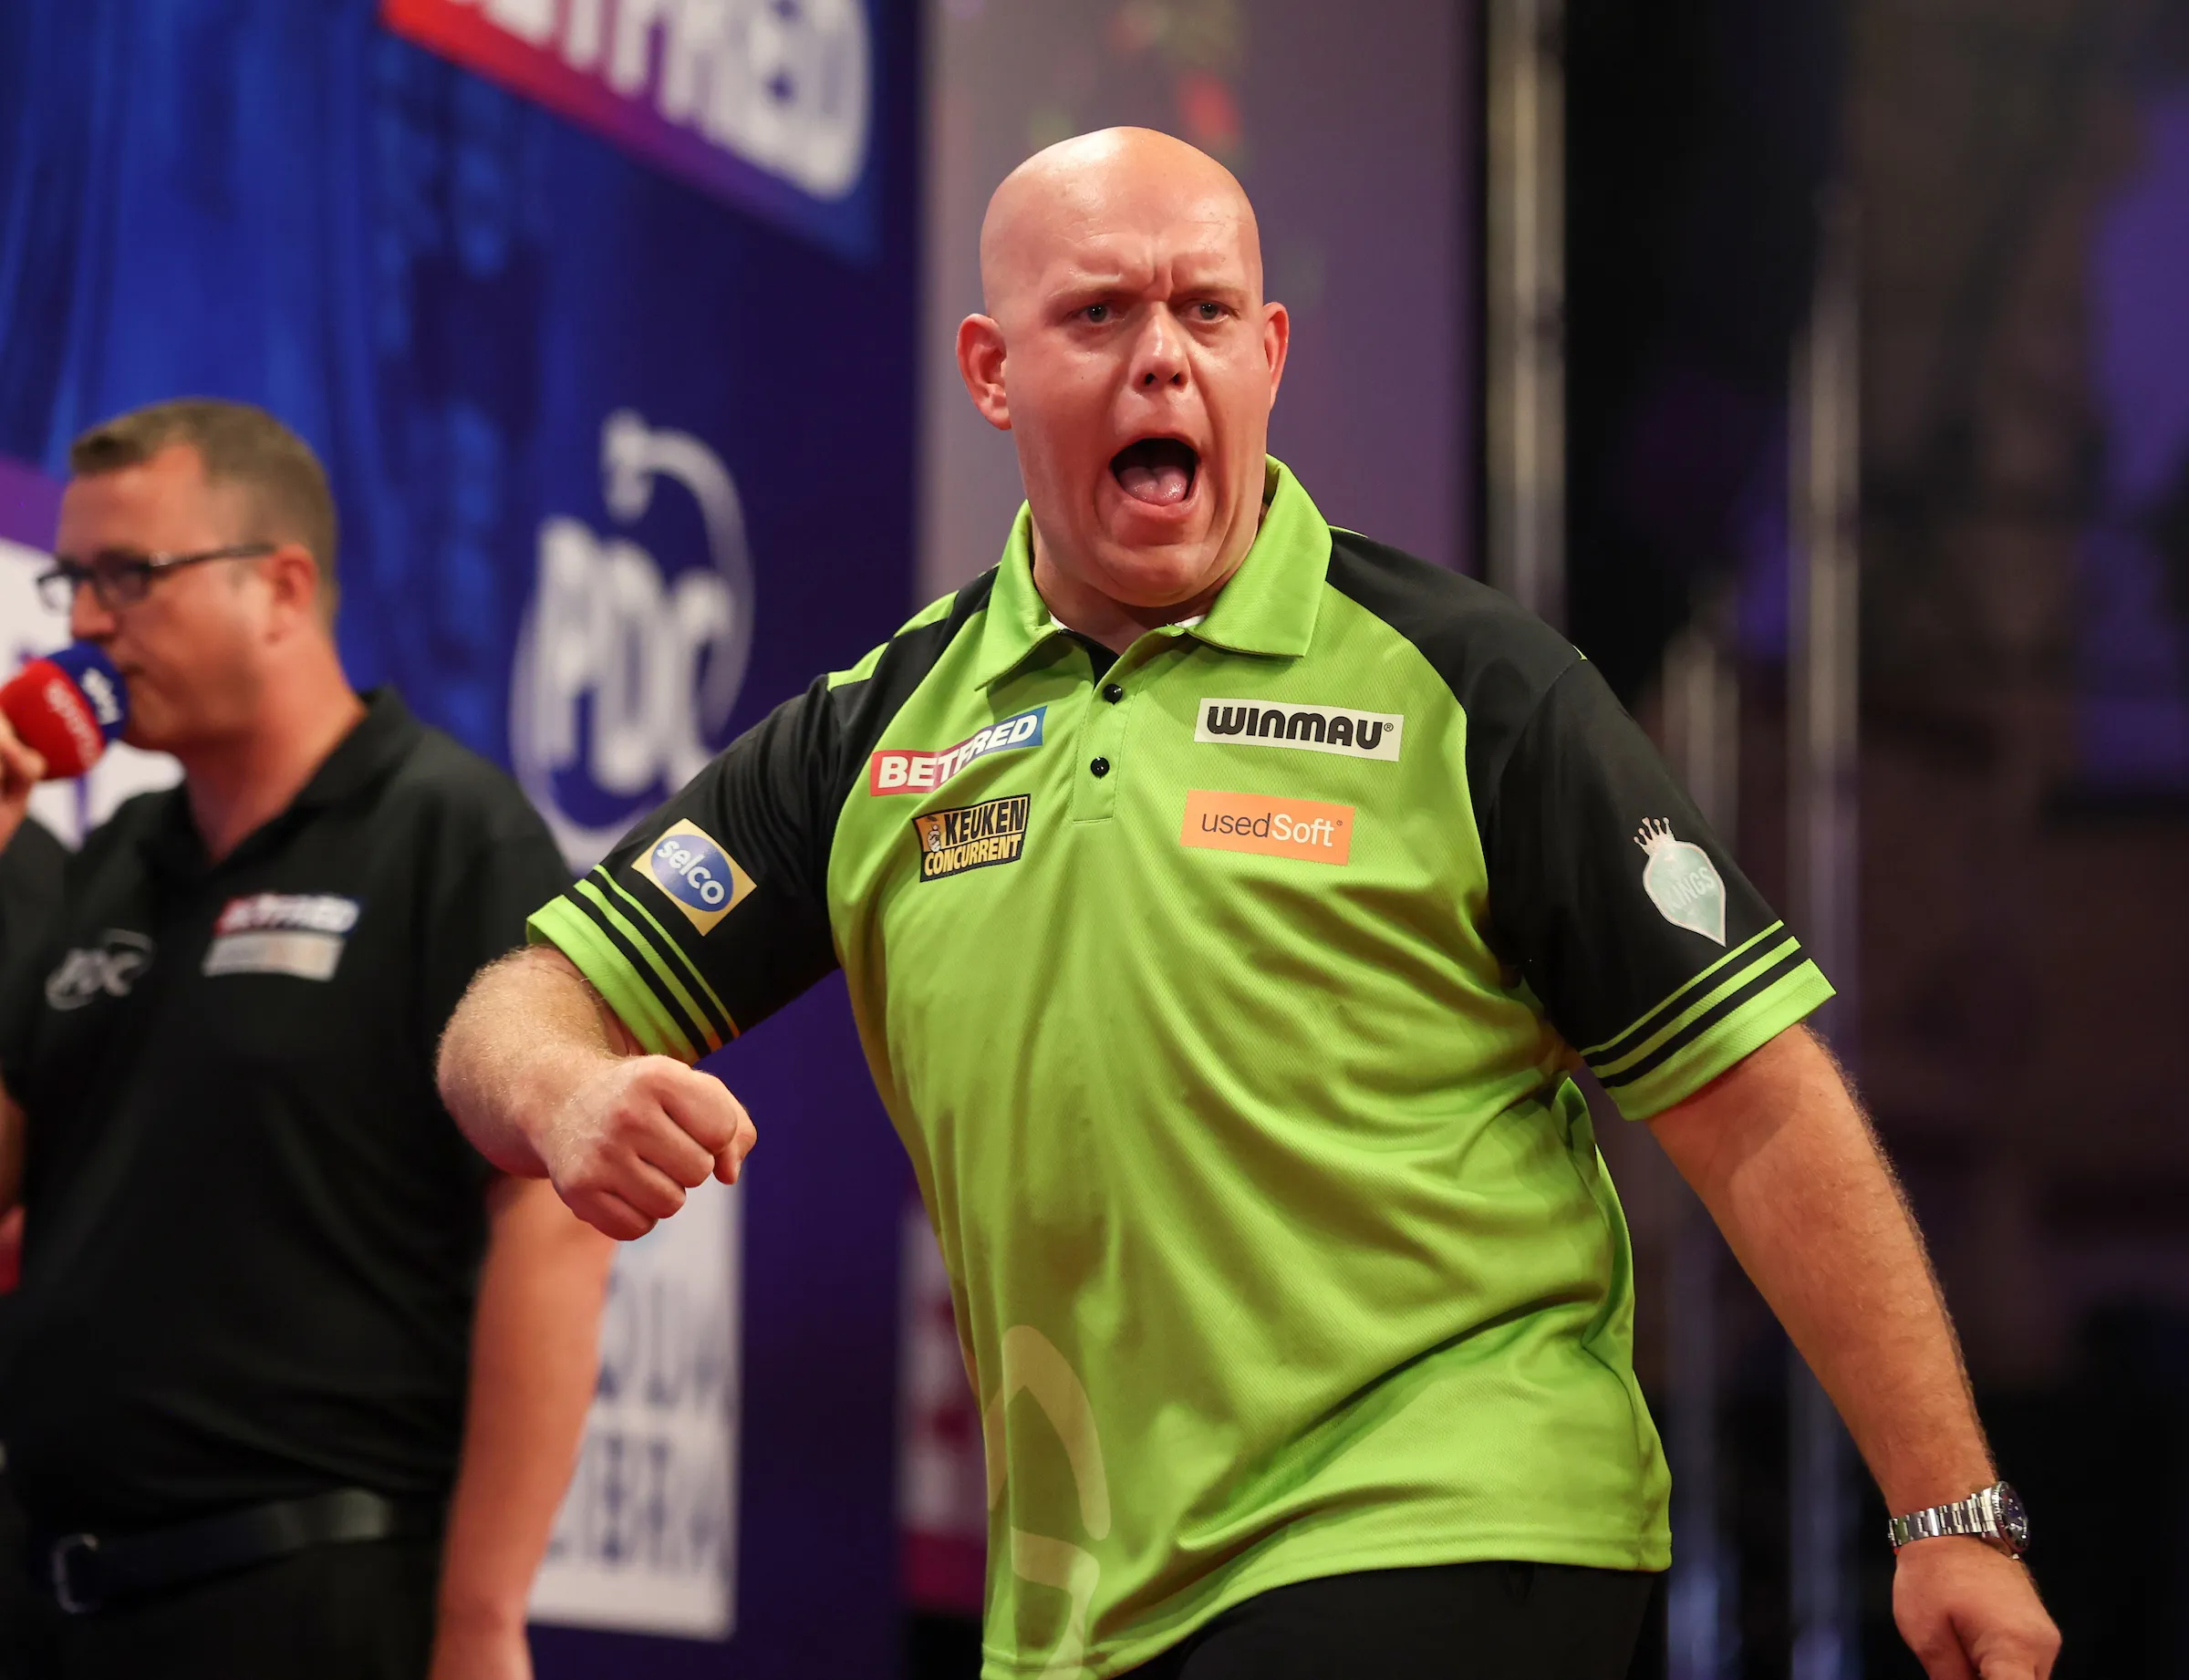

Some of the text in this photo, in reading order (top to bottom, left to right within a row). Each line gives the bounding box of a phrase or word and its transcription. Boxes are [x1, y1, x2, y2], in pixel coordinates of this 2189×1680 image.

[535, 513, 731, 797] PDC
[877, 714, 1038, 789] BETFRED
[943, 798, 1026, 846] KEUKEN
[1201, 812, 1334, 848] usedSoft
[656, 840, 725, 905] selco
[924, 834, 1022, 876] CONCURRENT
